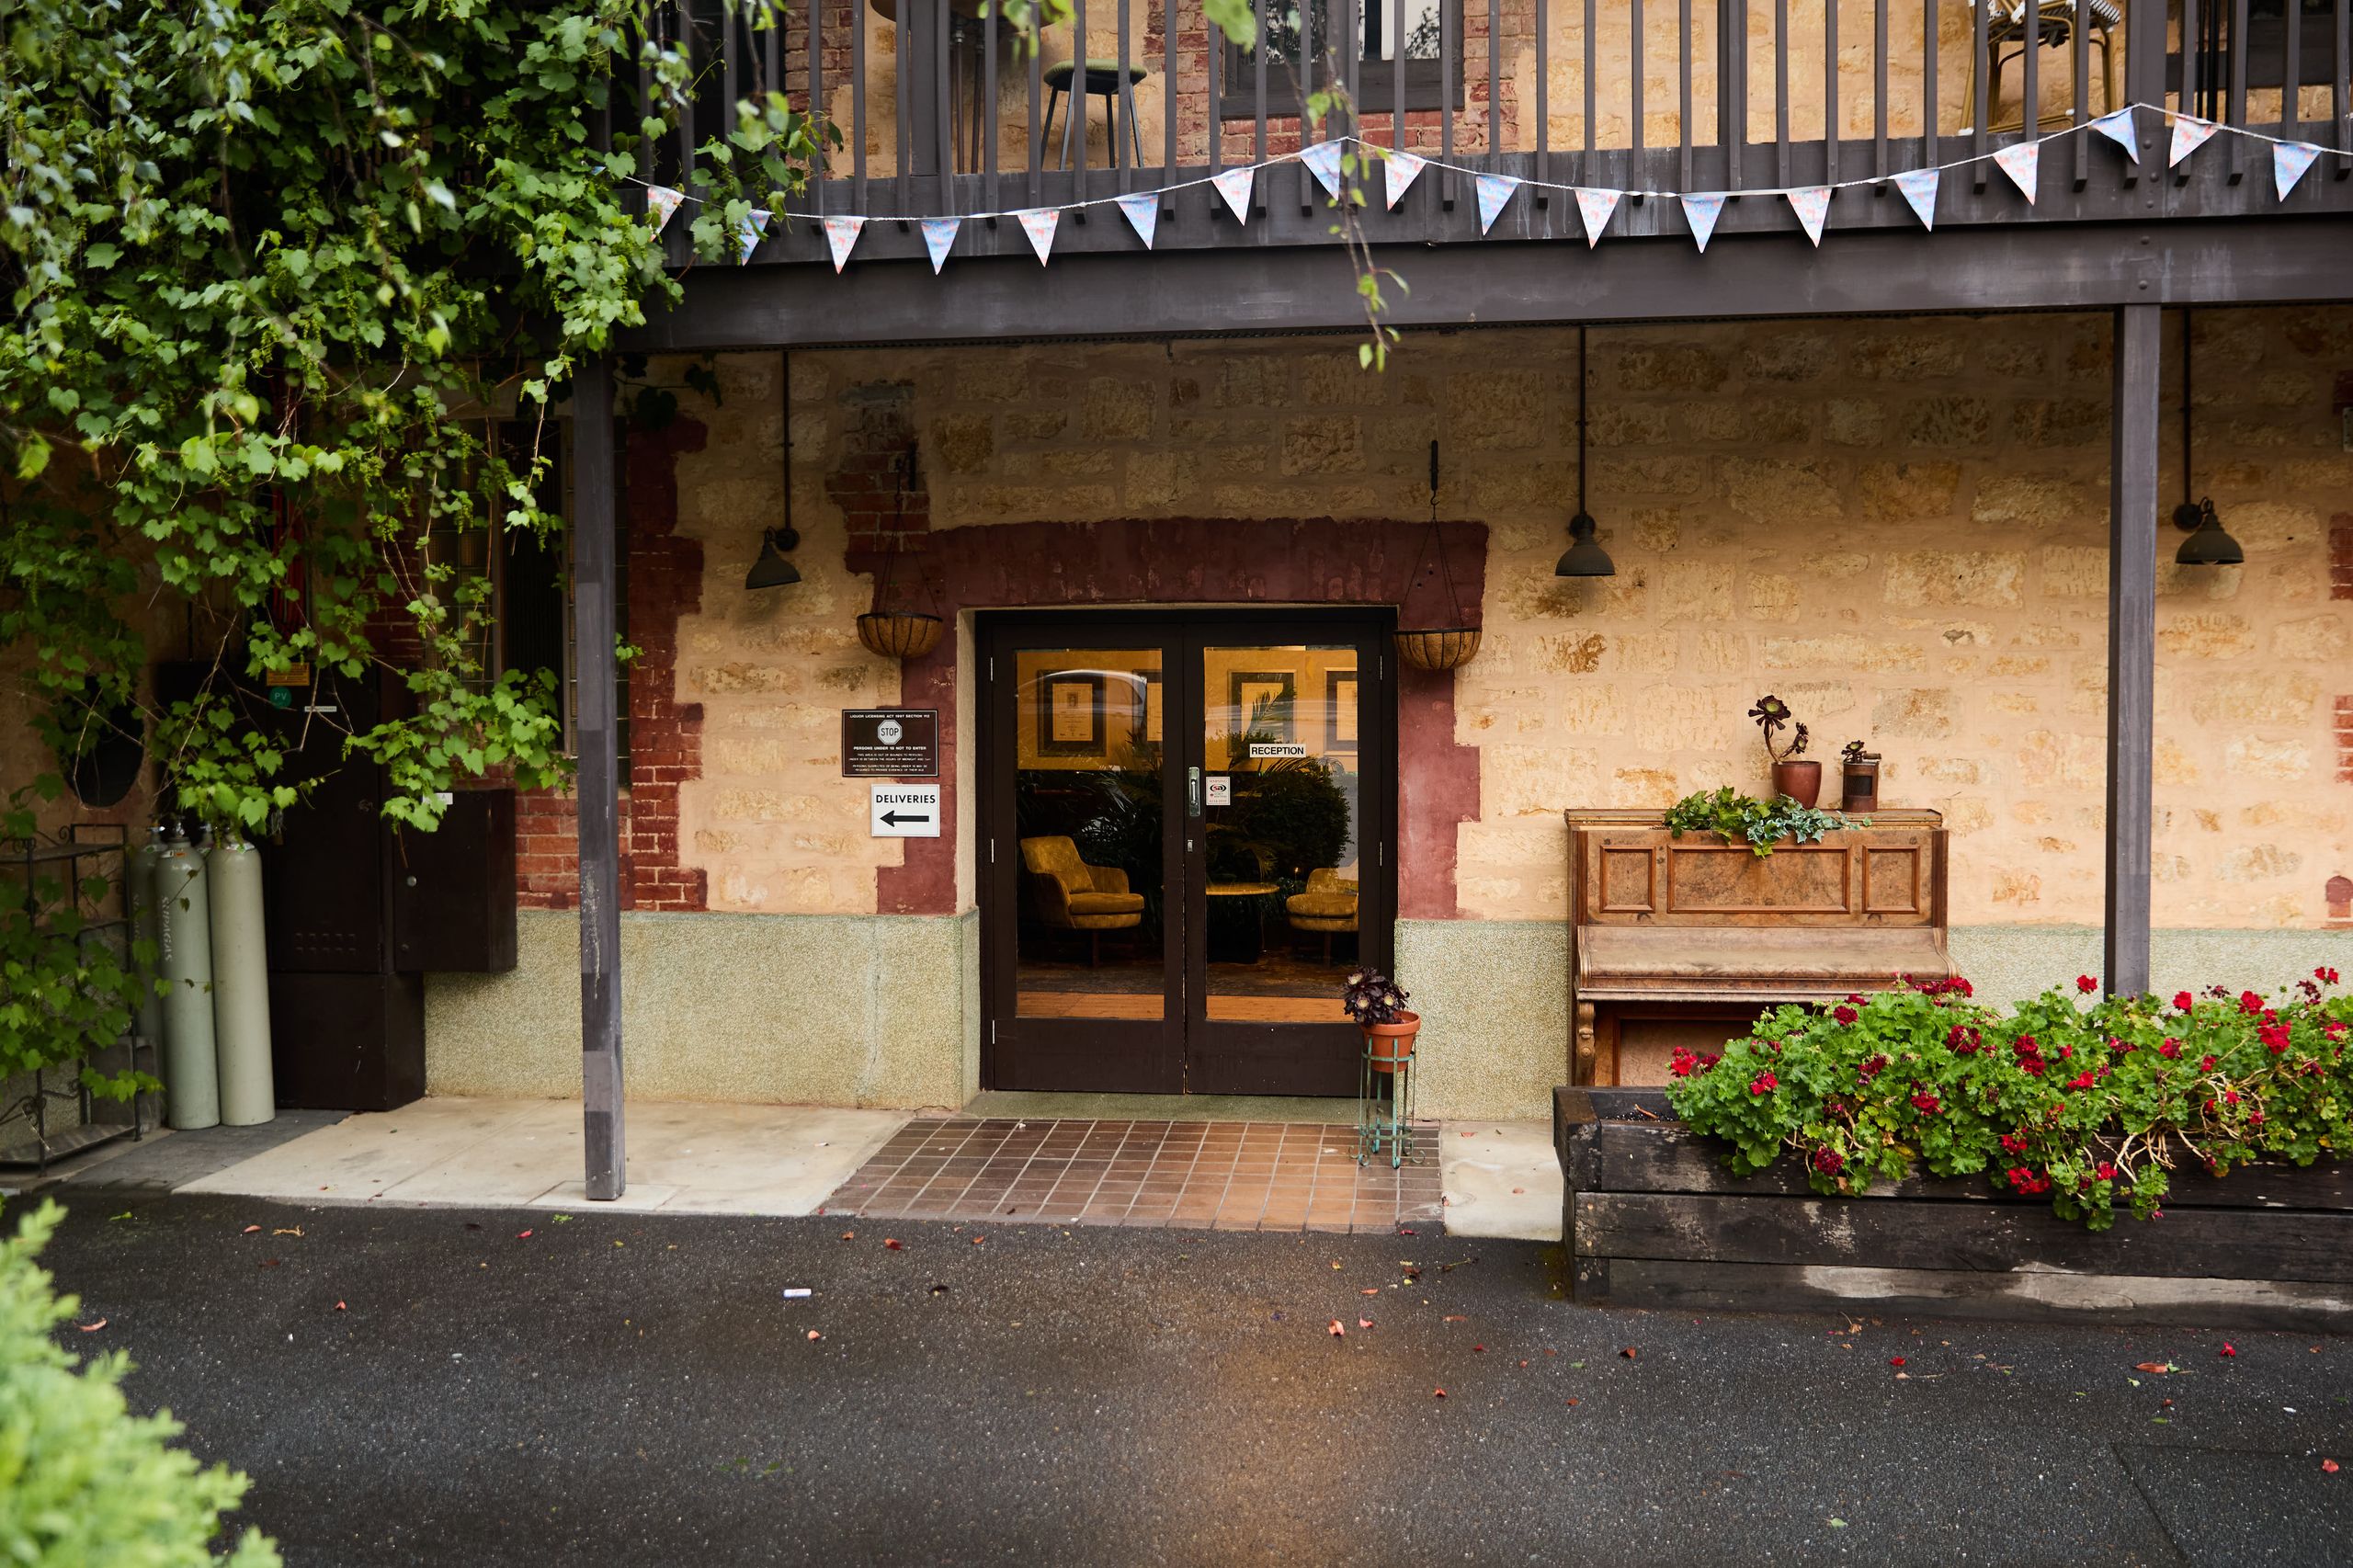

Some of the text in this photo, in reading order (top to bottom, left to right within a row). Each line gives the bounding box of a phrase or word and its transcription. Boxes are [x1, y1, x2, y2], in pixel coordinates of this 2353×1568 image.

[274, 692, 287, 700] PV
[881, 727, 899, 736] STOP
[876, 795, 936, 804] DELIVERIES
